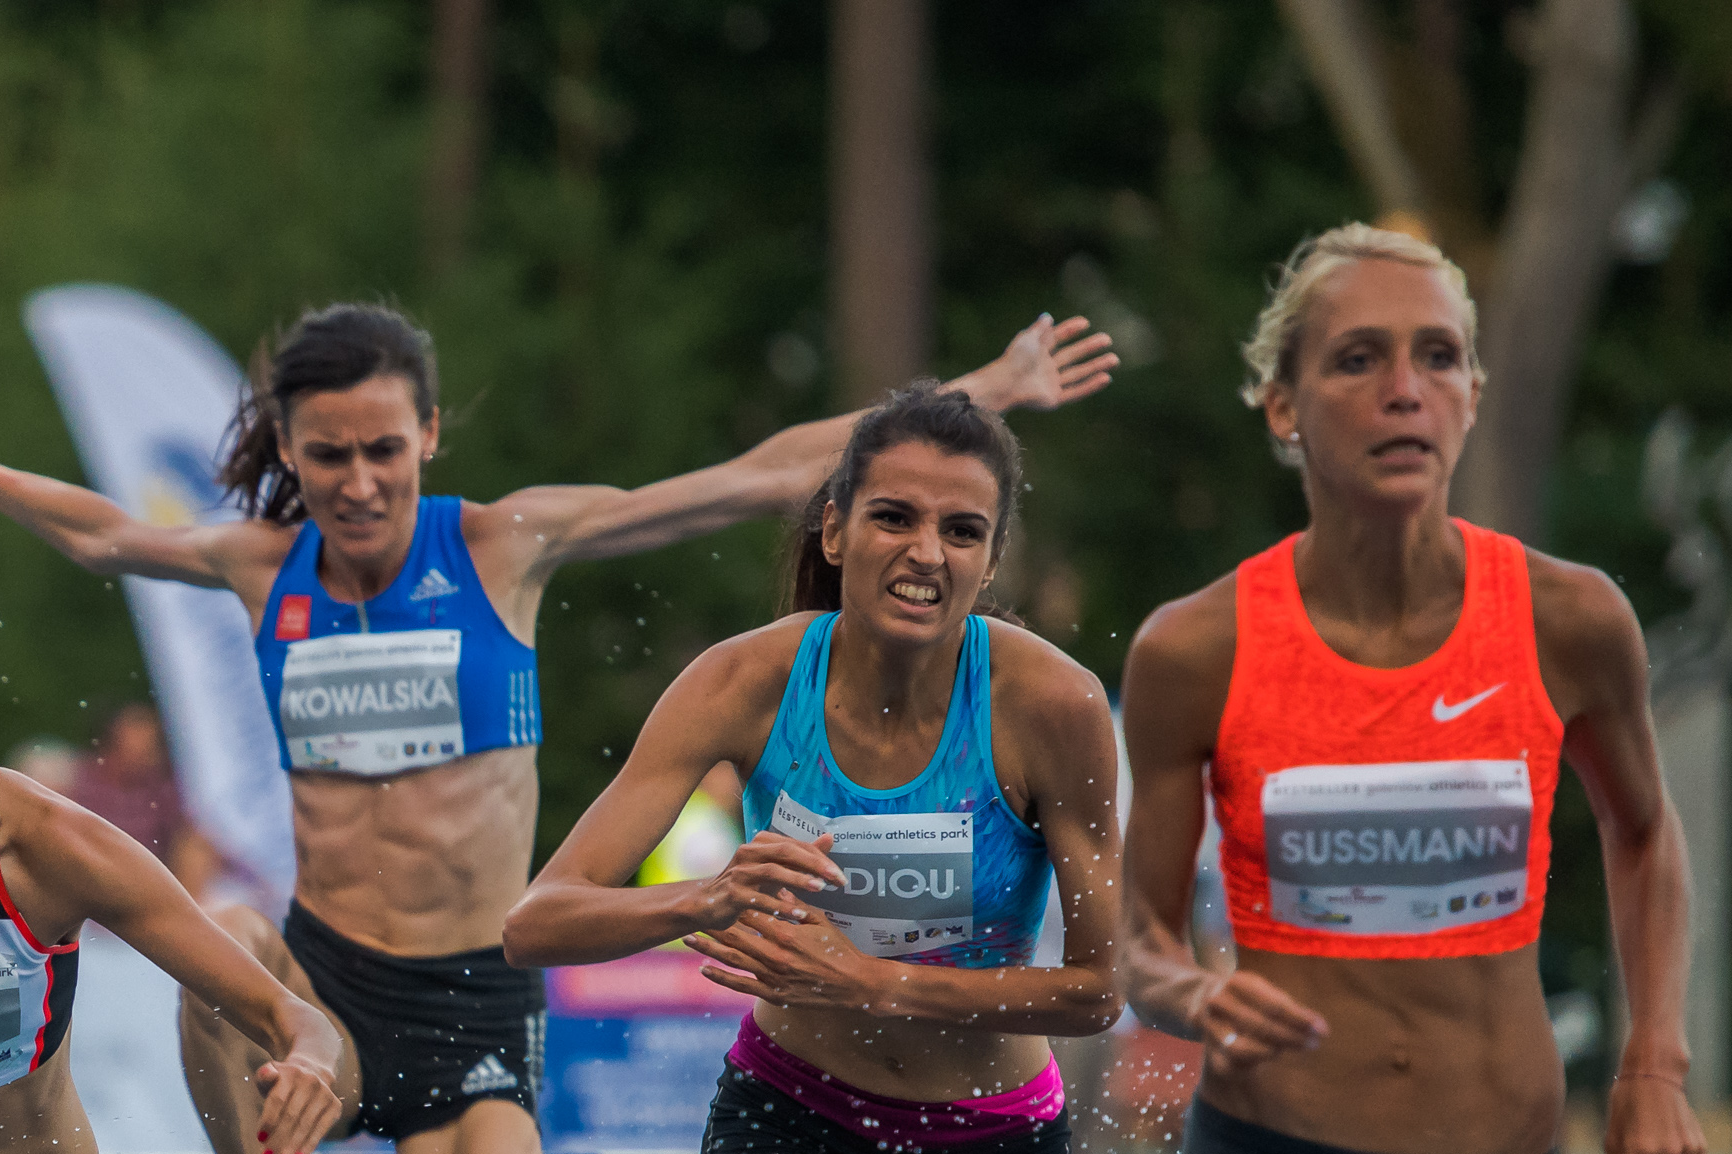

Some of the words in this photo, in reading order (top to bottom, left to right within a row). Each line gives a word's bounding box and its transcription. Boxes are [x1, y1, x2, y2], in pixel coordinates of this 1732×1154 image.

[288, 677, 455, 719] KOWALSKA
[833, 831, 882, 842] goleniów
[885, 829, 936, 840] athletics
[940, 829, 968, 841] park
[1280, 824, 1518, 865] SUSSMANN
[824, 867, 955, 899] DIOU
